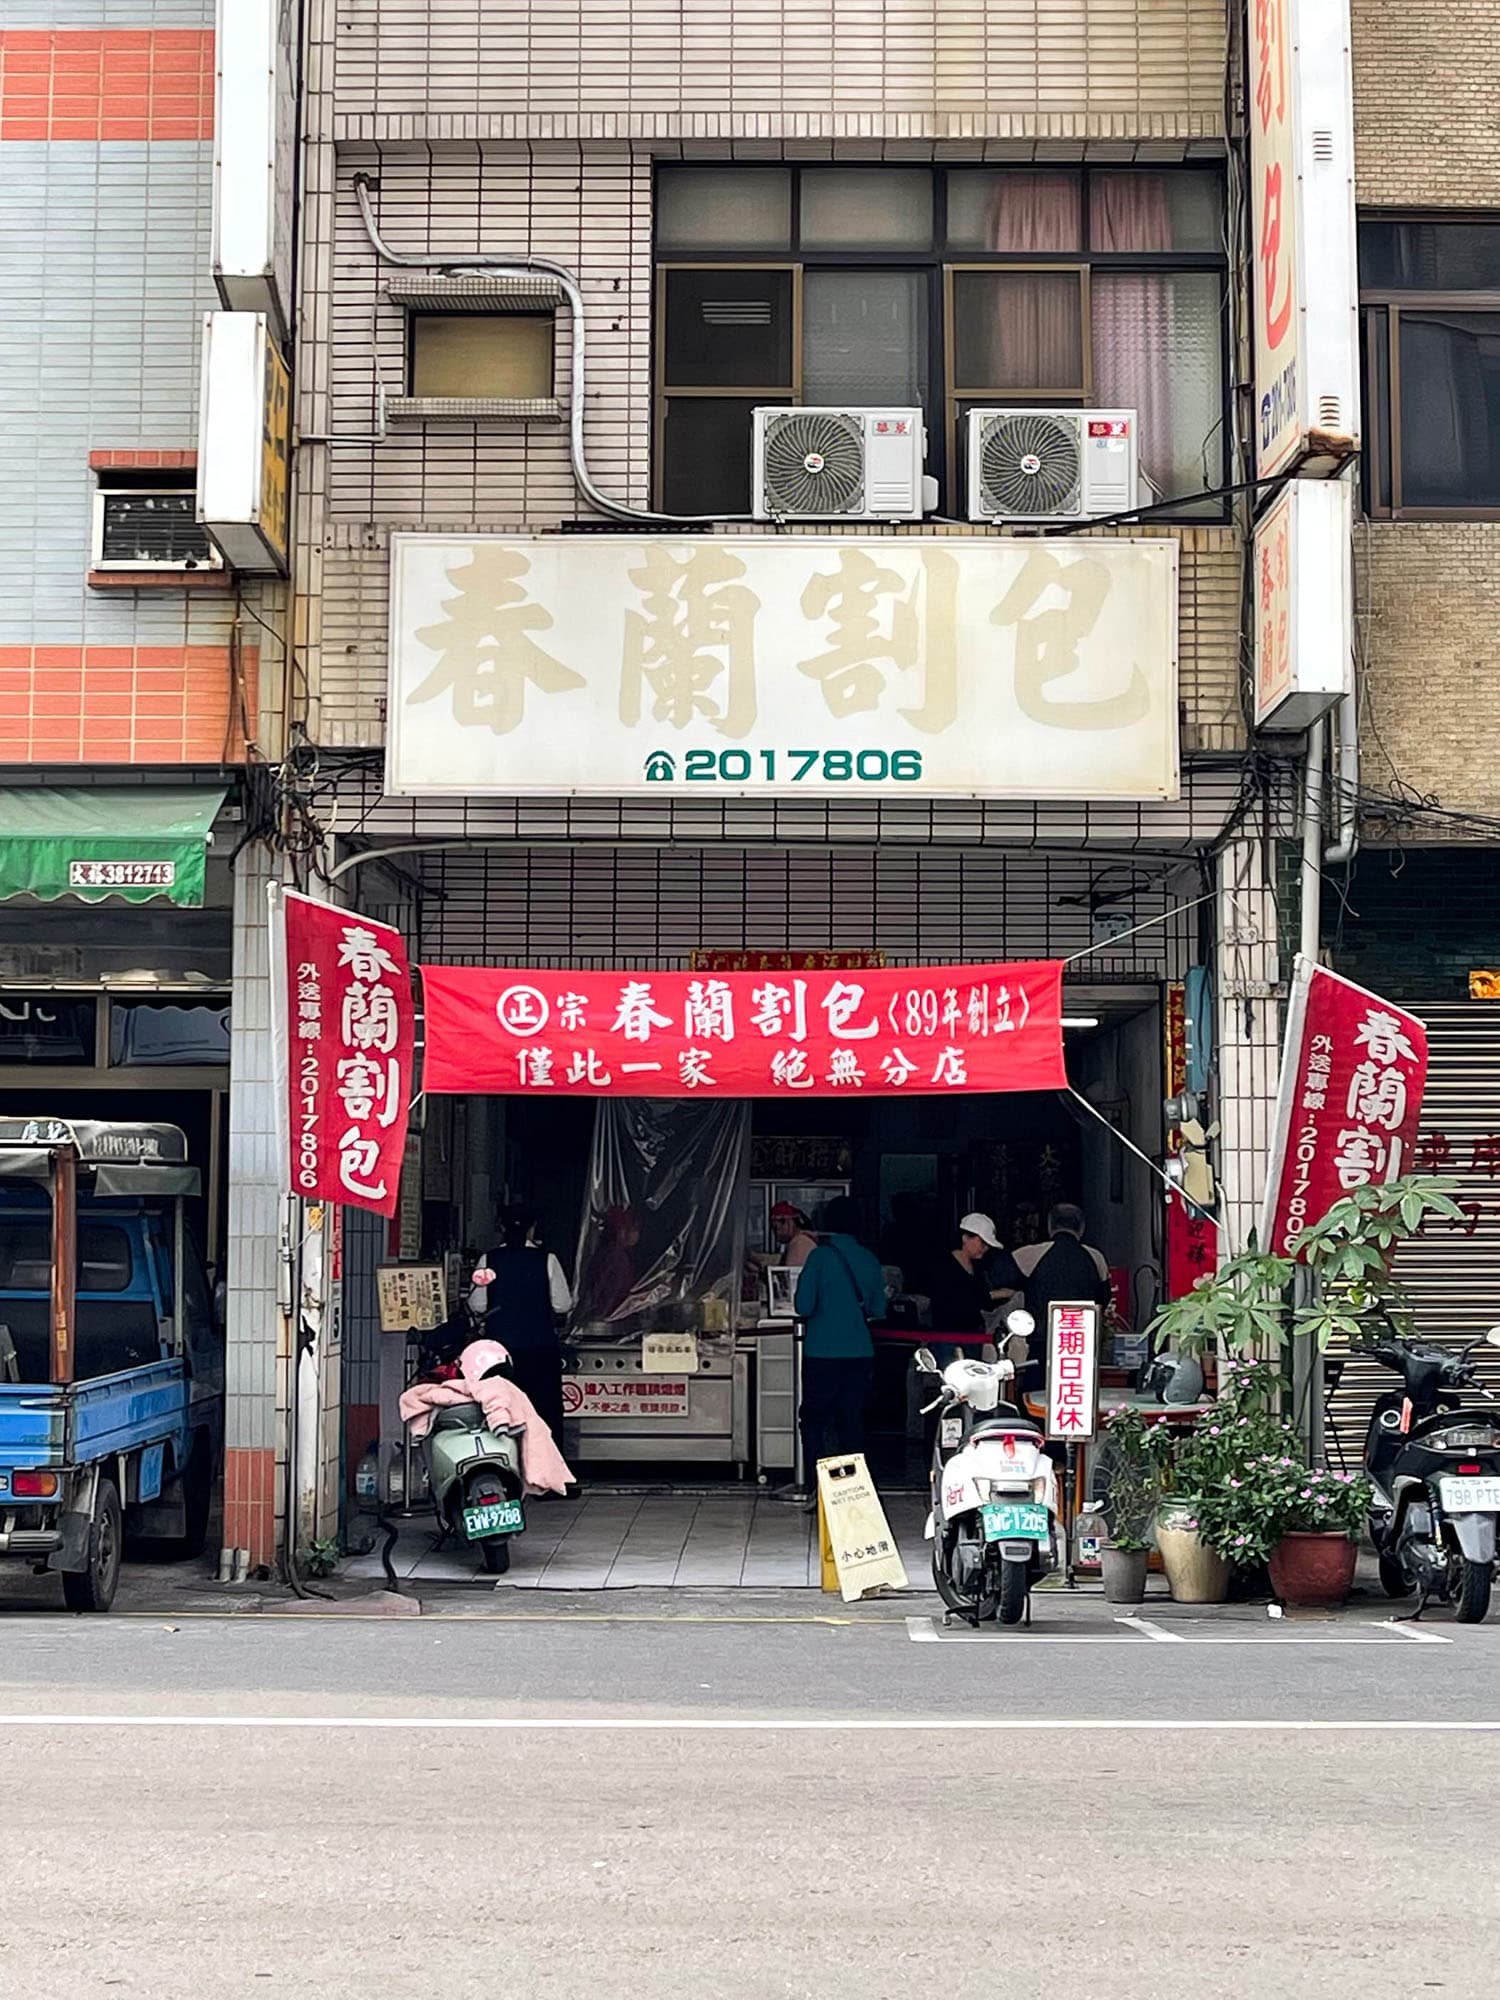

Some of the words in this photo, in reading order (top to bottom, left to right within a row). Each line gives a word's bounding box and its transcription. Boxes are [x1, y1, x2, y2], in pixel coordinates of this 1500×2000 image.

[406, 542, 1151, 740] 春蘭割包
[685, 749, 922, 781] 2017806
[609, 979, 880, 1043] 春蘭割包
[337, 926, 402, 1200] 春蘭割包
[515, 1046, 718, 1089] 僅此一家
[770, 1046, 968, 1089] 絕無分店
[1330, 1009, 1420, 1232] 春蘭割
[1056, 1307, 1085, 1431] 星期日店休
[841, 1540, 889, 1562] 小心地滑
